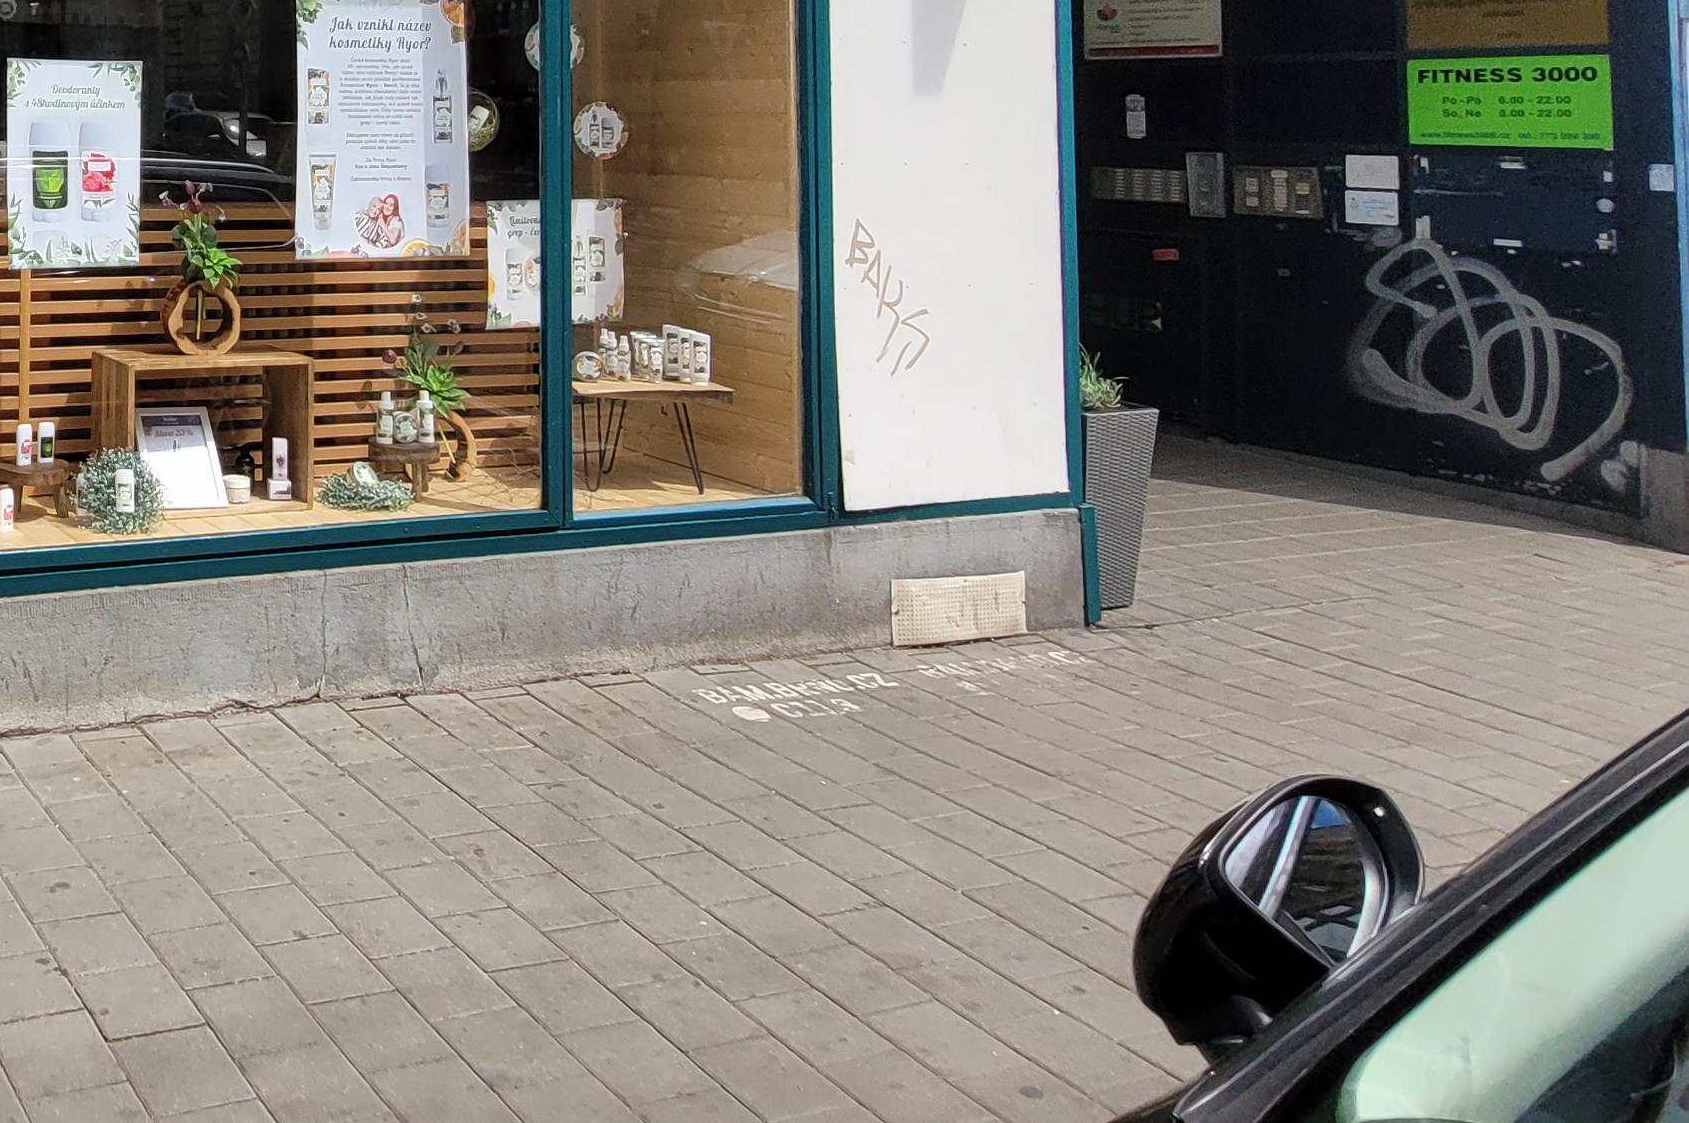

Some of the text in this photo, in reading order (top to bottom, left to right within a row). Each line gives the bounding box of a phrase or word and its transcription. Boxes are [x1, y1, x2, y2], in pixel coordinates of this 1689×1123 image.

[329, 16, 432, 34] Jak vznikl název
[328, 36, 432, 54] kosmetiky Ryor?
[1417, 66, 1598, 84] FITNESS 3000
